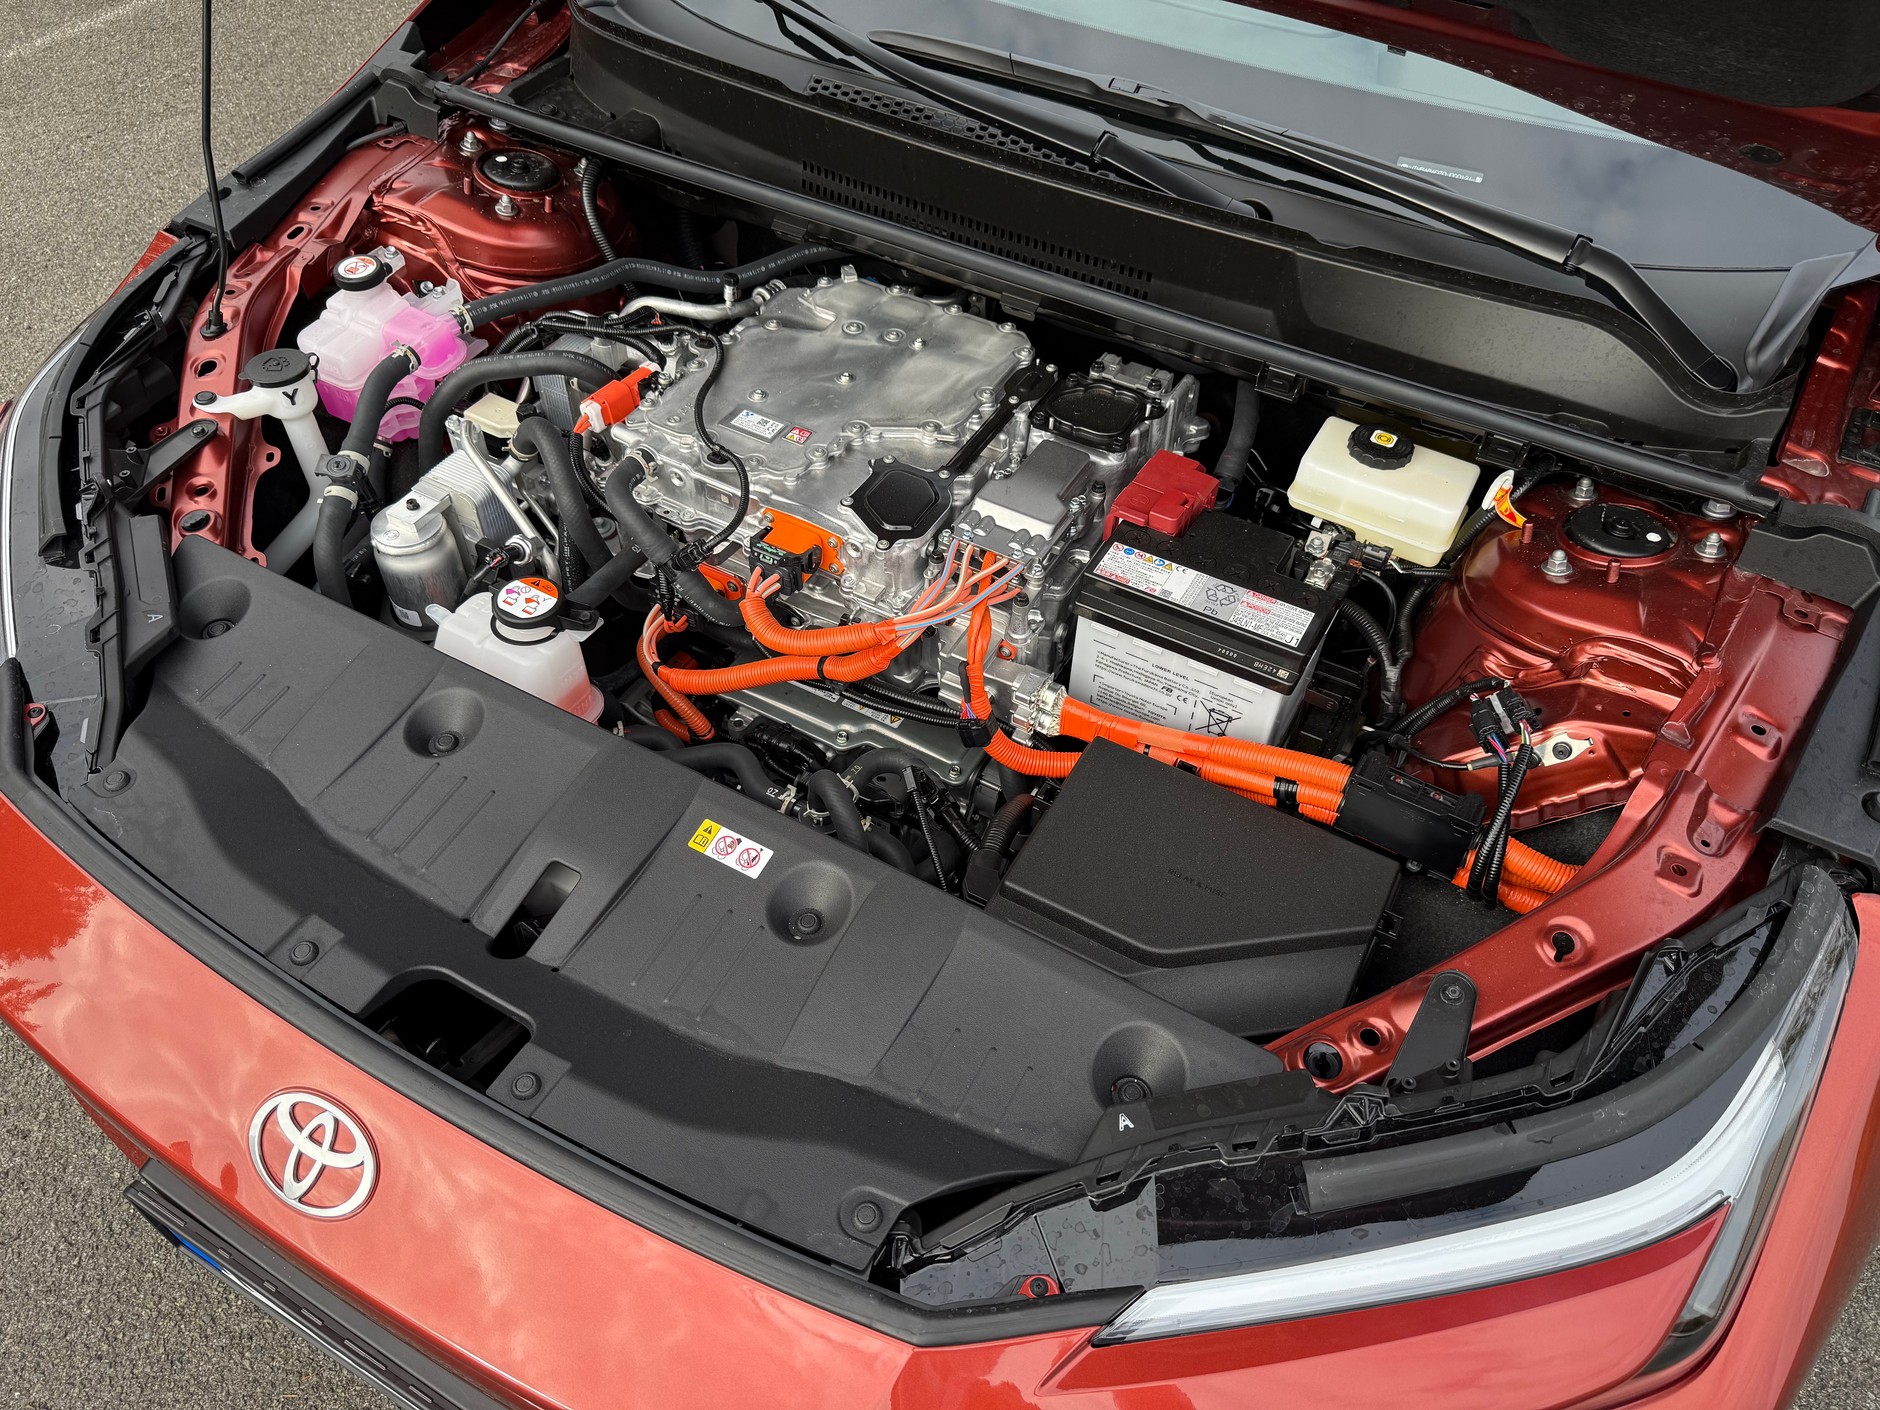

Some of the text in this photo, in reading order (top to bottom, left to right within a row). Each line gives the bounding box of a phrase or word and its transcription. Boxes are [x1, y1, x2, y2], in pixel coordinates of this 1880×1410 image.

[282, 388, 299, 406] Y
[1202, 606, 1218, 616] Pb
[147, 614, 164, 623] A
[1285, 636, 1299, 646] J1
[1151, 663, 1189, 680] LOWER LEVEL
[1147, 709, 1166, 720] TOYOTA
[1119, 1113, 1134, 1132] A
